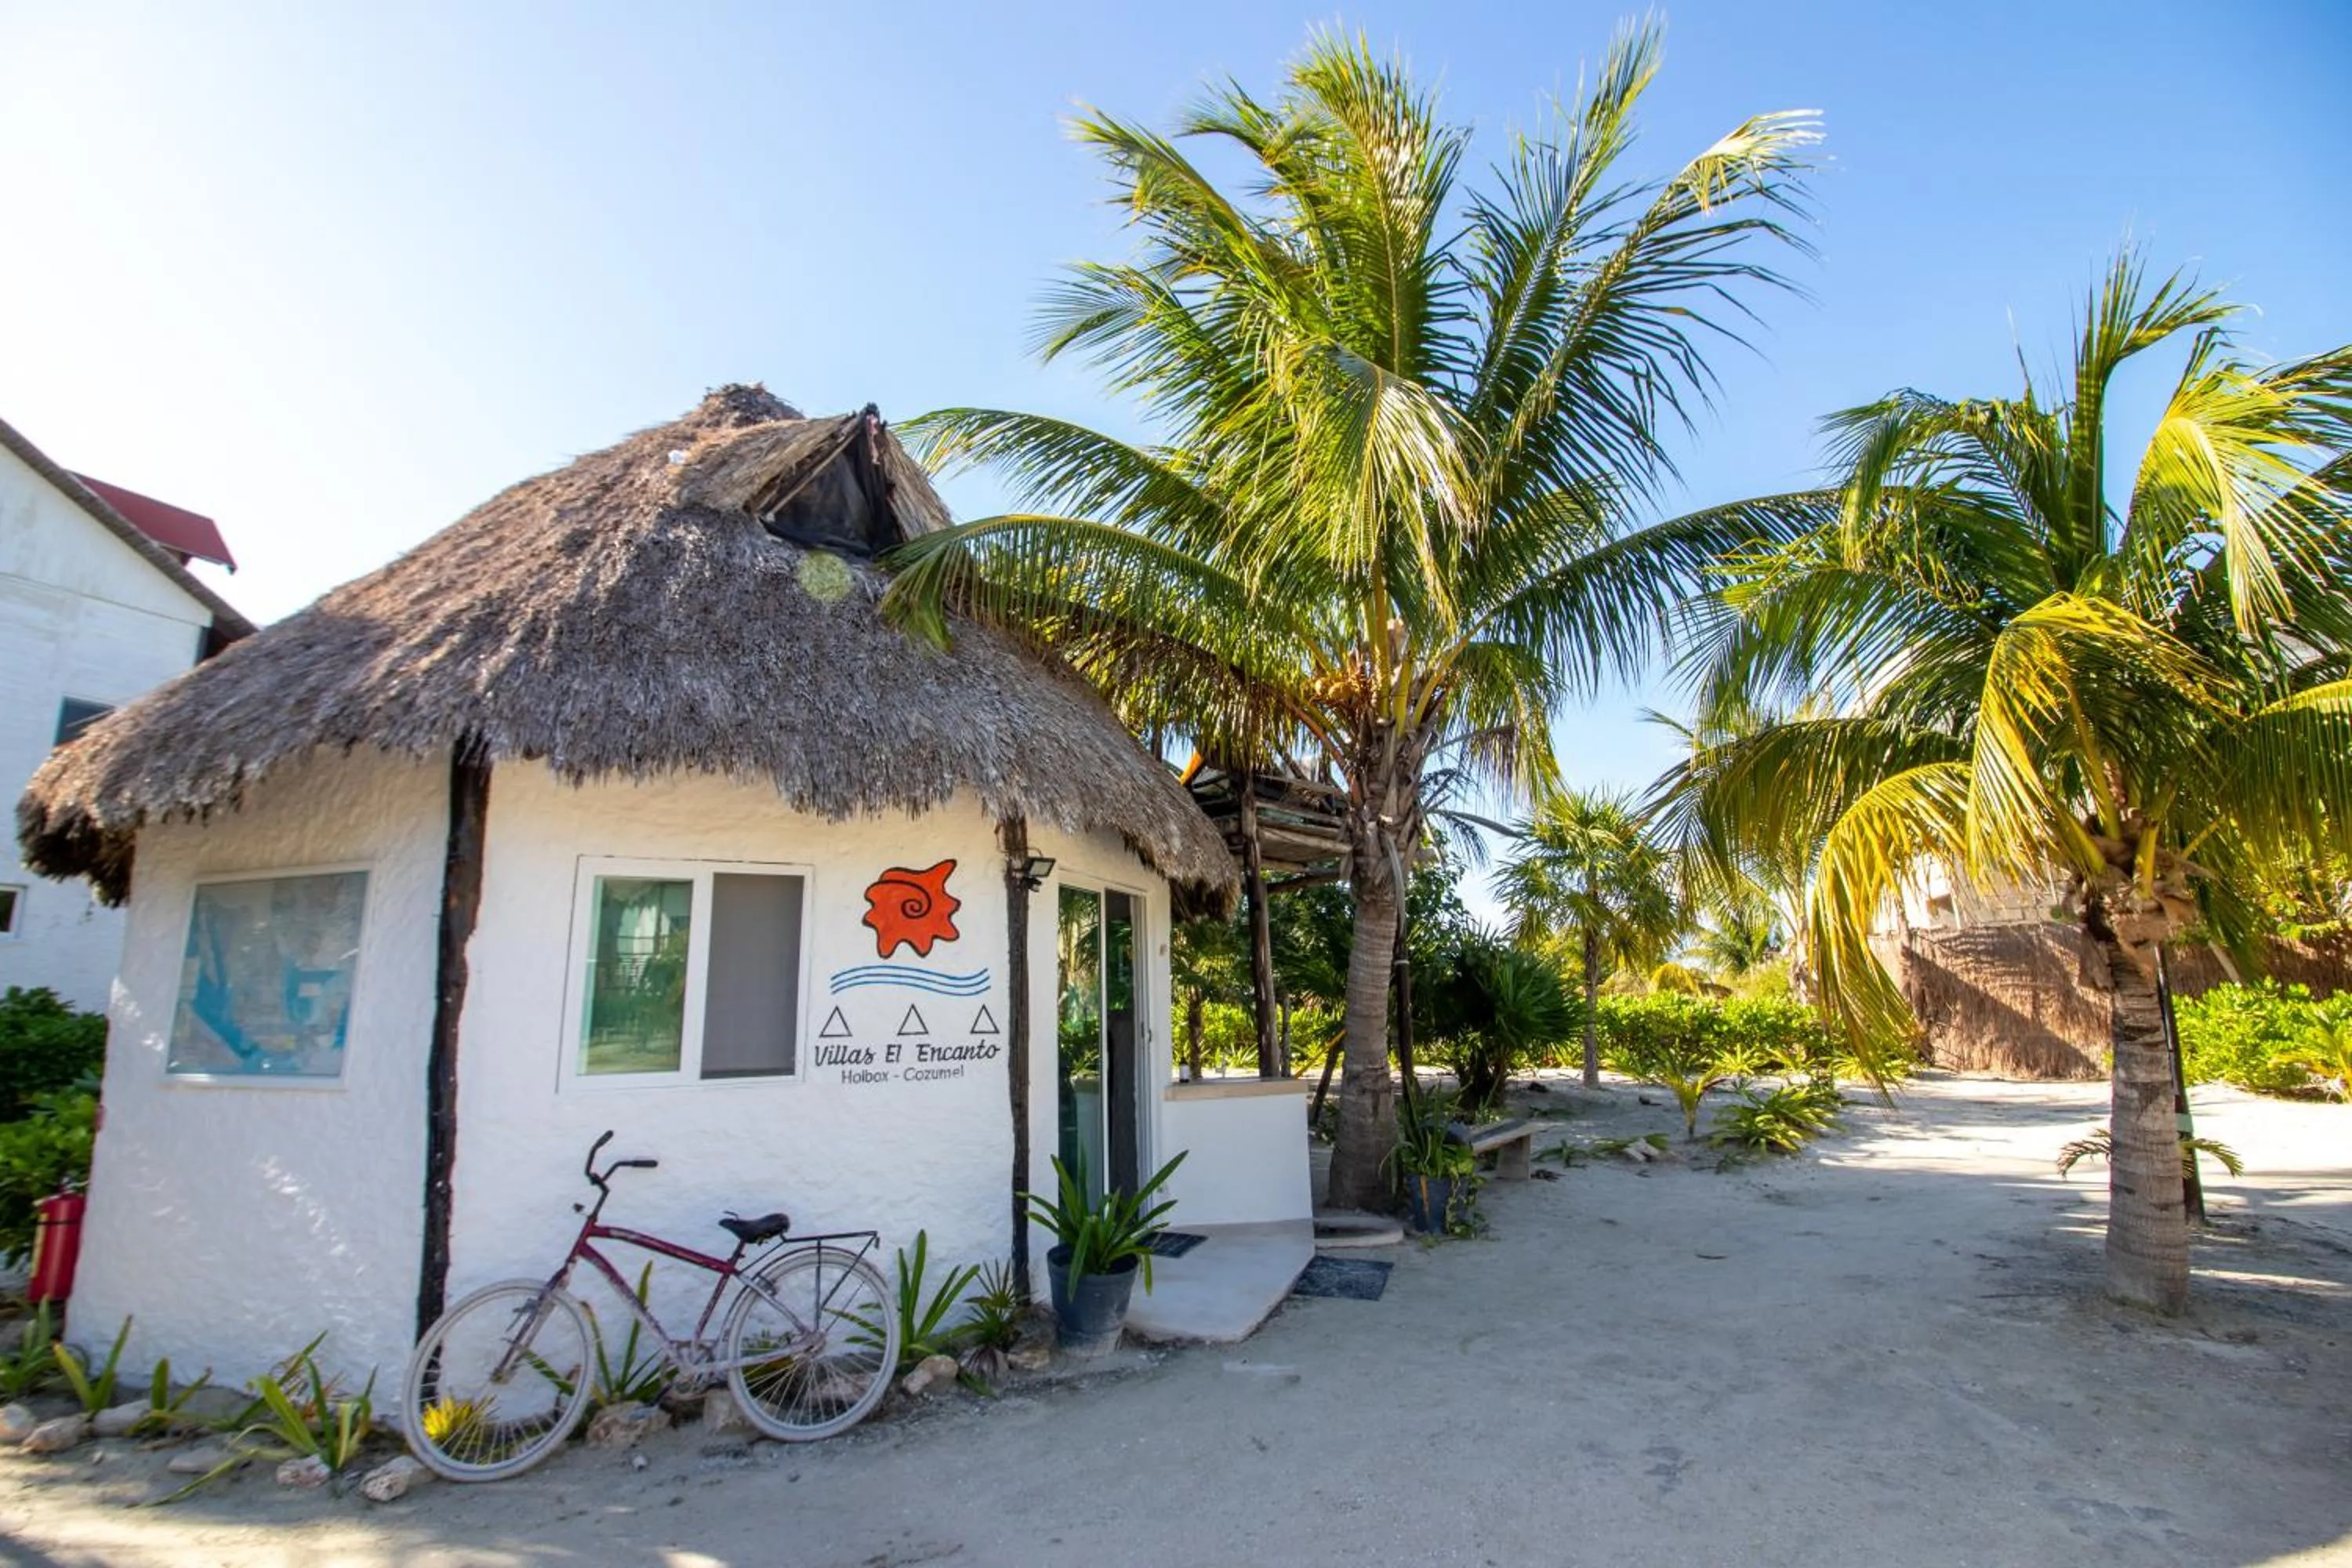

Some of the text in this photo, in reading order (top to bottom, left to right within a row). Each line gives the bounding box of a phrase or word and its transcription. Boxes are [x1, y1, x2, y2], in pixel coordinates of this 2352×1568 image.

[815, 1039, 1000, 1066] Villas El Encanto
[841, 1069, 889, 1084] Holbox
[903, 1065, 964, 1082] Cozumel
